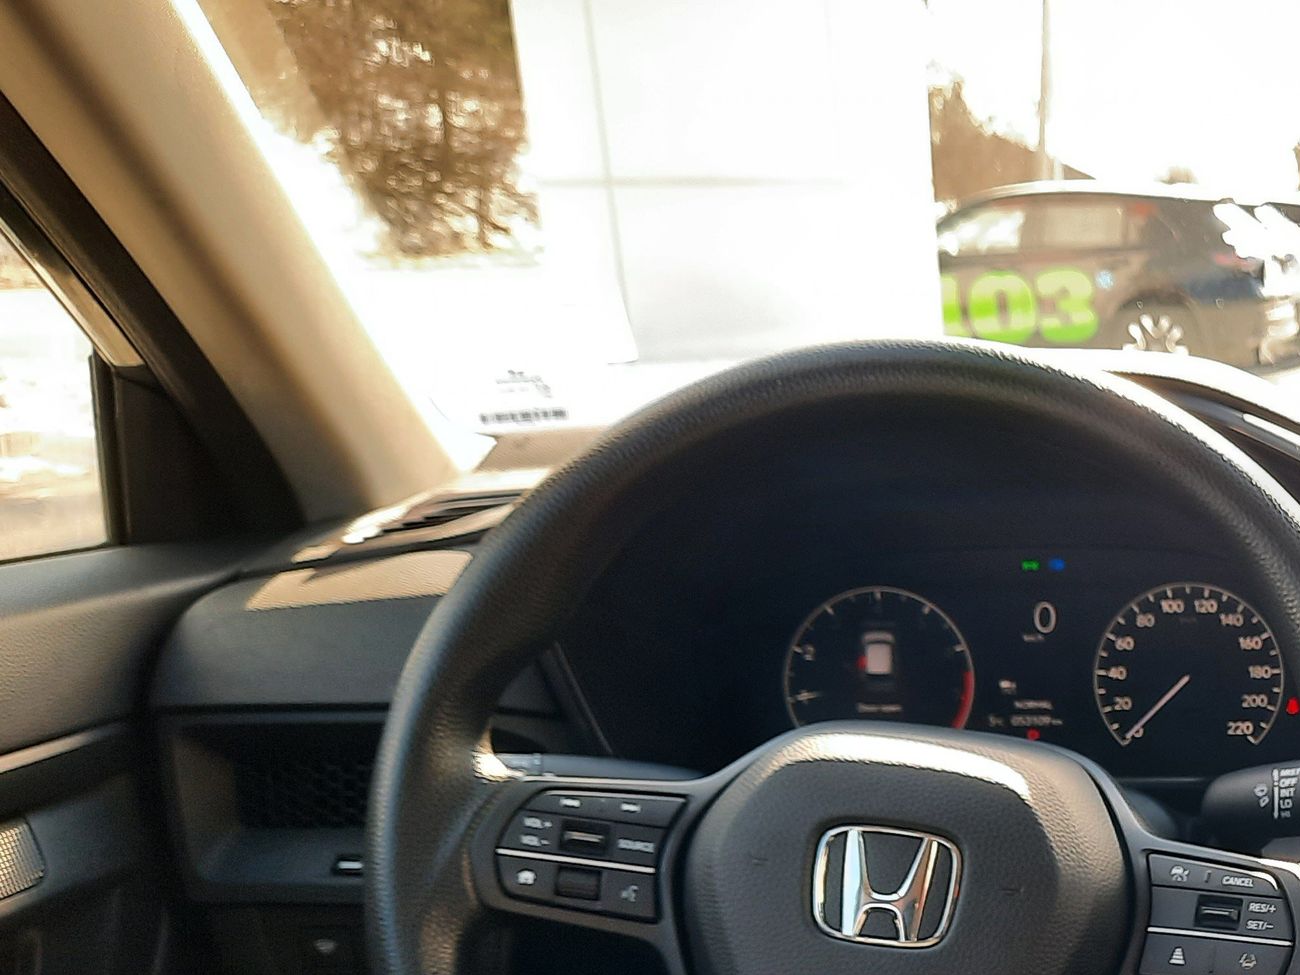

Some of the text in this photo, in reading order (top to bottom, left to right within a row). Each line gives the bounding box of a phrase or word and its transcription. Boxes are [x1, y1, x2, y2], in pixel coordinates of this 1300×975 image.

[1161, 599, 1185, 614] 100
[1034, 601, 1057, 634] 0
[1241, 694, 1268, 708] 200
[1227, 720, 1253, 736] 220
[1222, 875, 1254, 888] CANCEL
